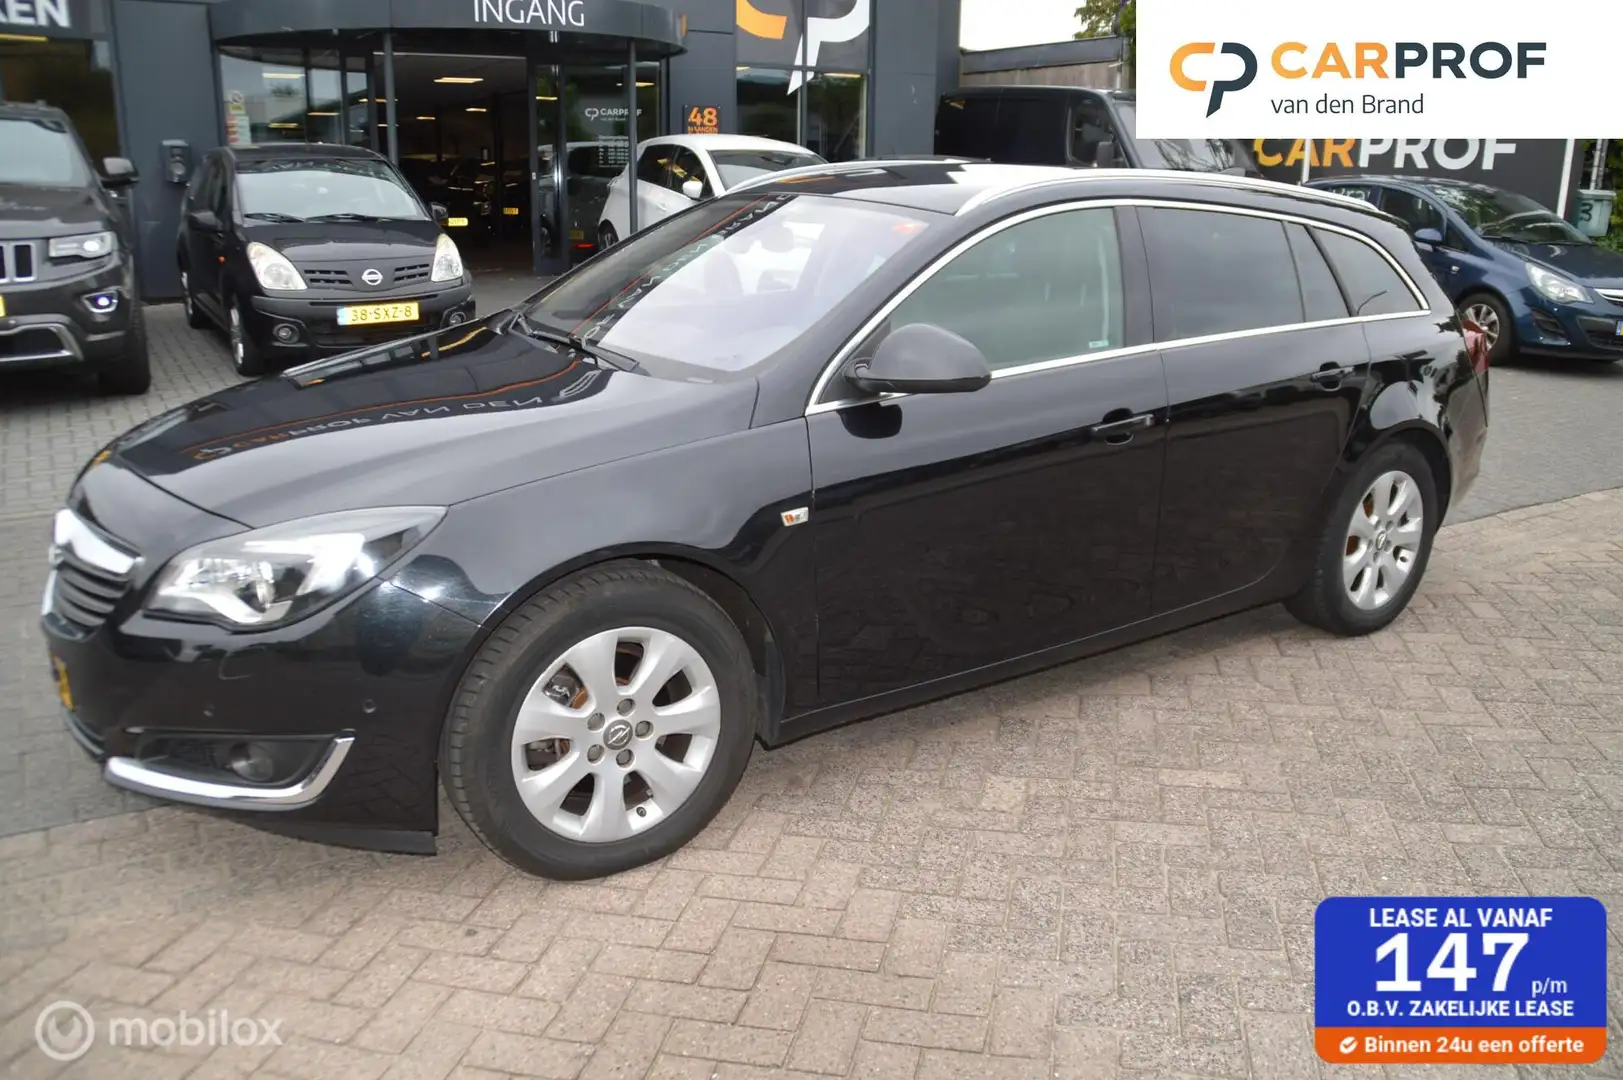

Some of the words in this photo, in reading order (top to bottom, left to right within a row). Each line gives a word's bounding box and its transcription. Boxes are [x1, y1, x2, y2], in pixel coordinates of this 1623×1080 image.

[474, 0, 585, 27] INGANG
[688, 106, 718, 126] 48
[1253, 139, 1516, 170] CARPROF
[351, 305, 412, 321] 38-SXZ-8
